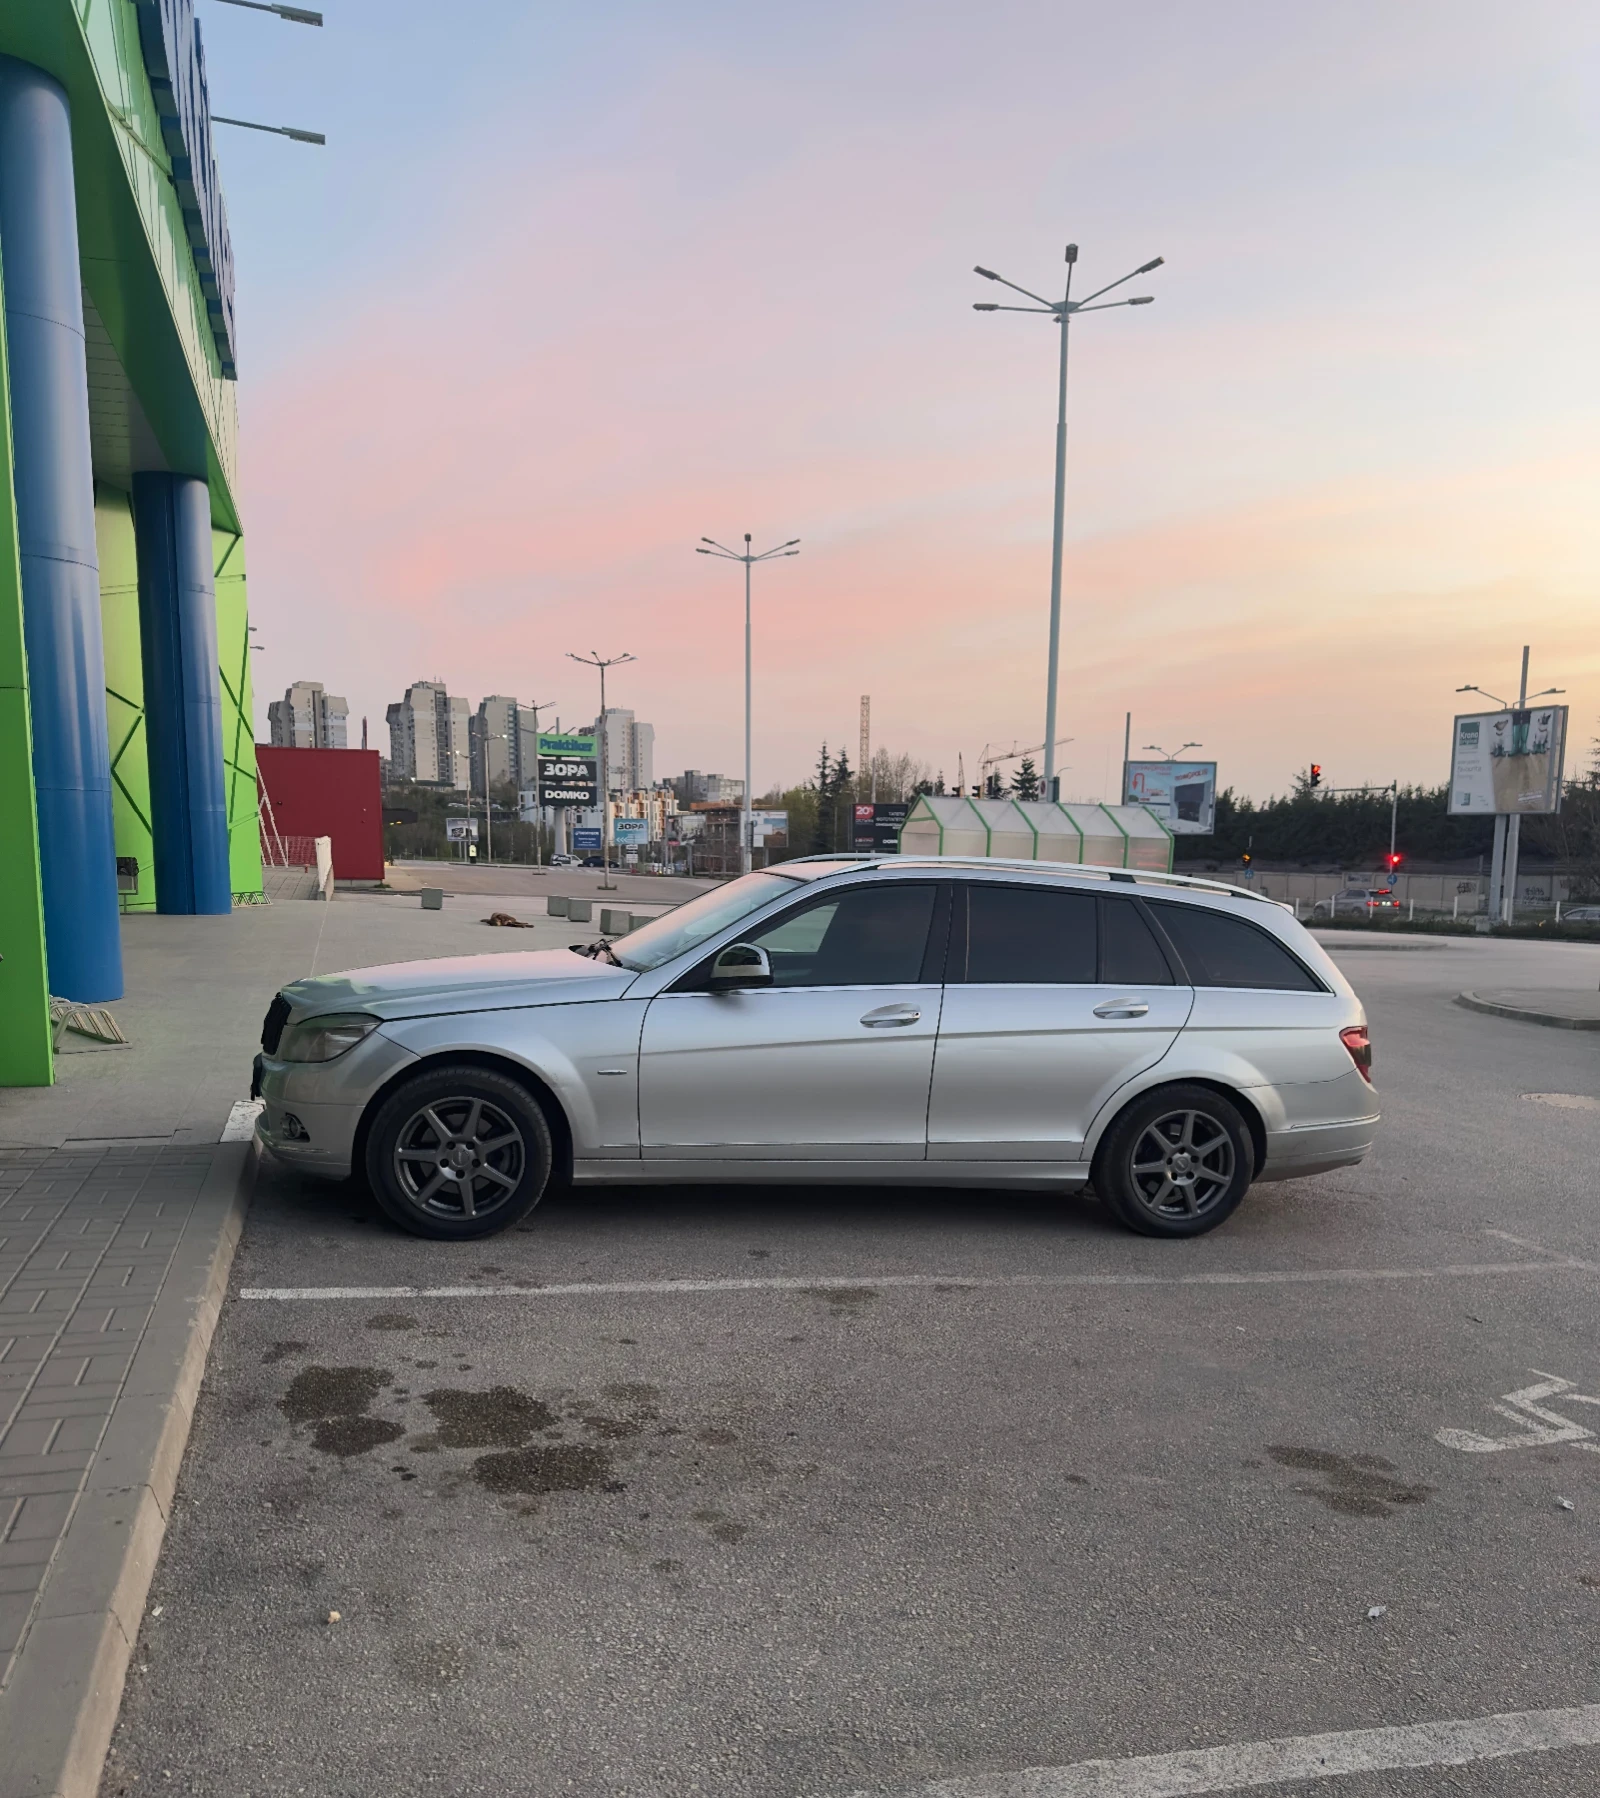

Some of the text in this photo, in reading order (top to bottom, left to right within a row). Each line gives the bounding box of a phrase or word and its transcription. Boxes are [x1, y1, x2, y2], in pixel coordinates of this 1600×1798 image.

[540, 738, 594, 752] Praktiker
[544, 763, 589, 777] ЗОРА
[545, 789, 590, 800] DOMKO
[618, 823, 645, 831] ЗОРА
